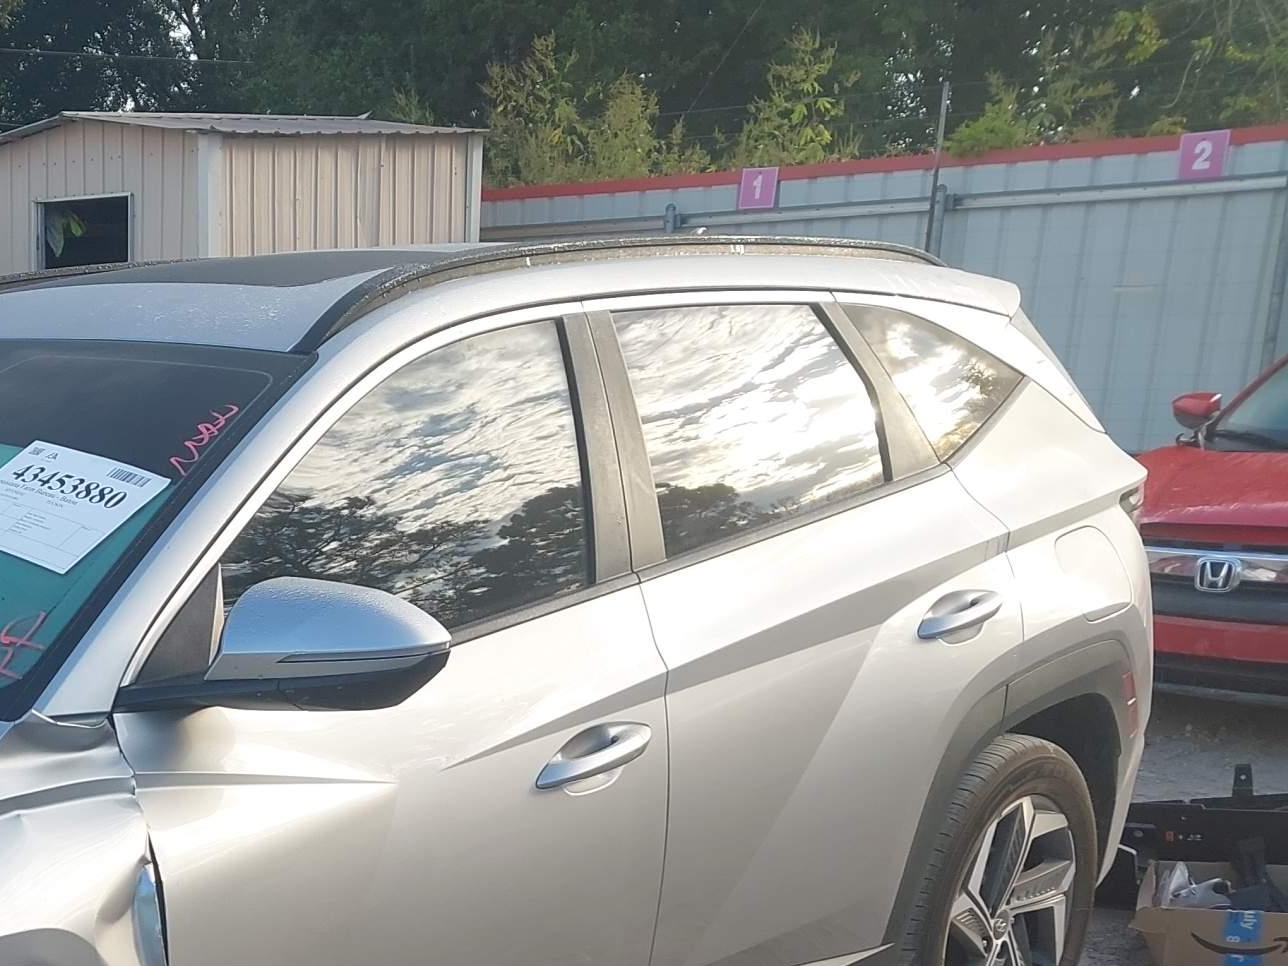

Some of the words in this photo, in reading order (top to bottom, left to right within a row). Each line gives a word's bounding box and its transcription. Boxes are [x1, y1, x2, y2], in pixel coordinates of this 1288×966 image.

[1192, 141, 1212, 170] 2
[753, 175, 762, 200] 1
[12, 464, 128, 509] 43453880
